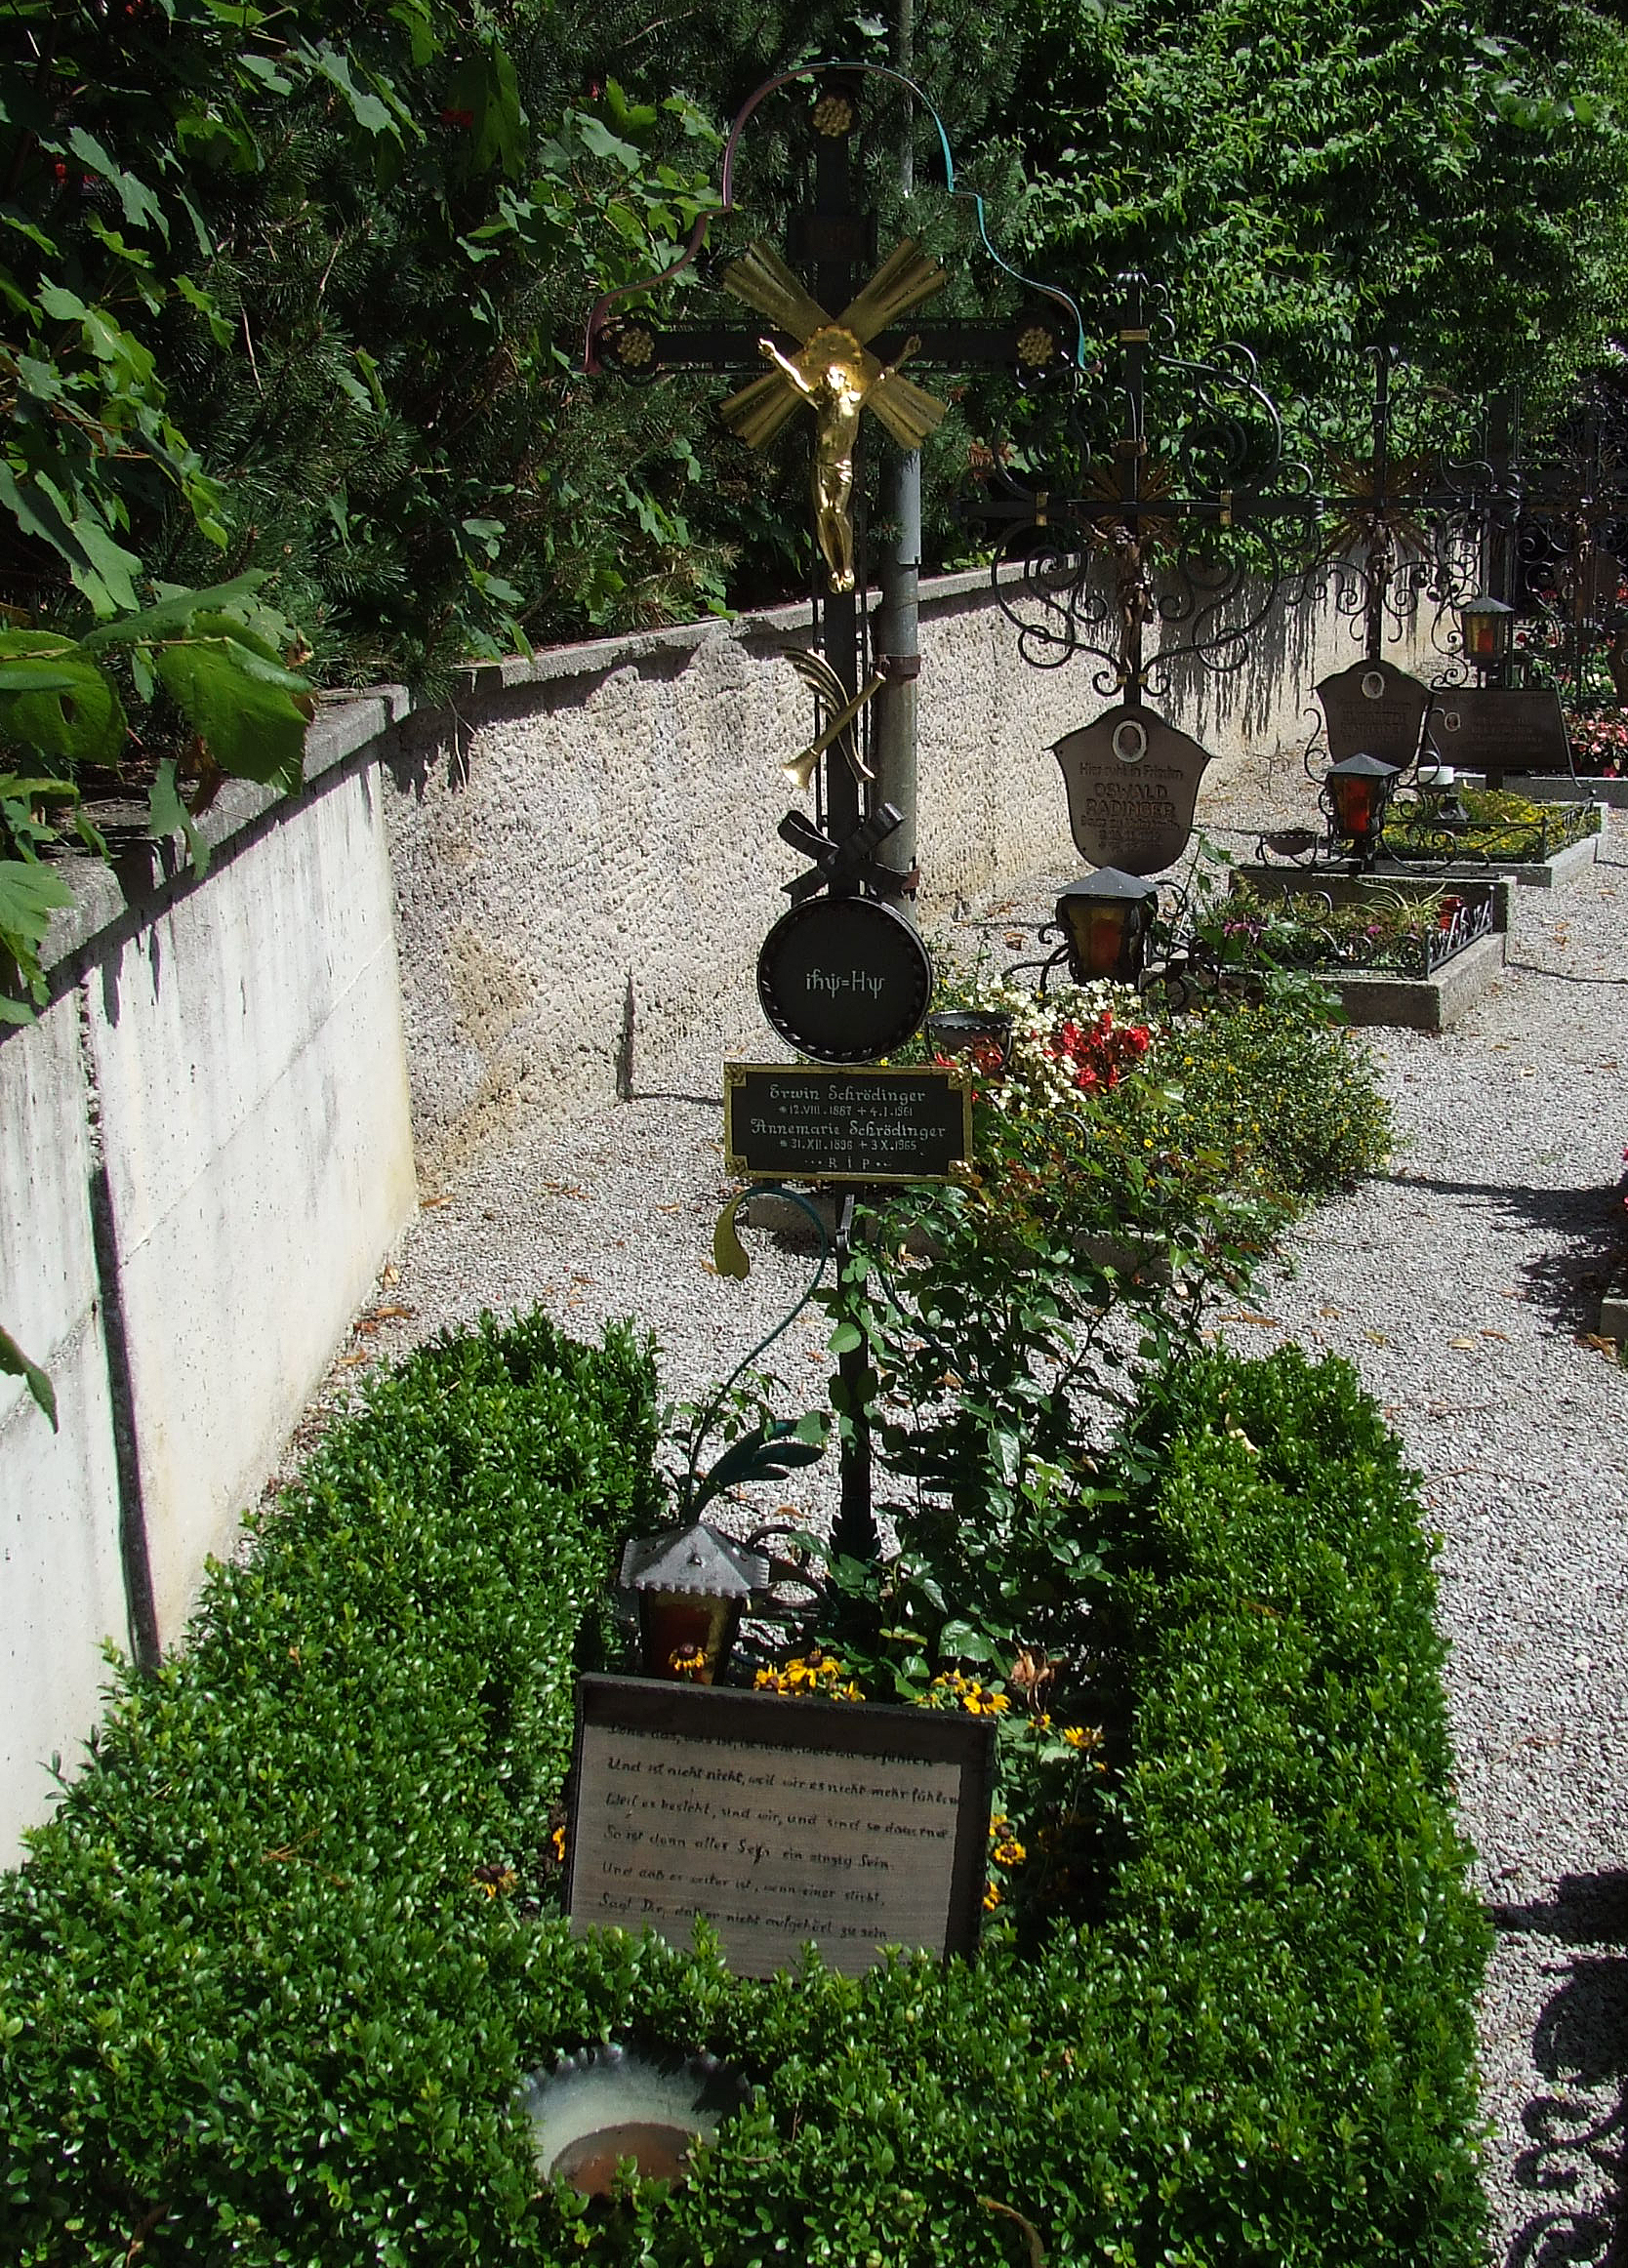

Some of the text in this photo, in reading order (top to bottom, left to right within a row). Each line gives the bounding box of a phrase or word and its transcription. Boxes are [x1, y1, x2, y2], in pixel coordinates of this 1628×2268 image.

[770, 1084, 925, 1106] Erwin Schrödinger
[750, 1118, 946, 1141] Annemarie Schrödinger
[607, 1757, 640, 1772] Und
[648, 1763, 664, 1775] ist
[668, 1766, 702, 1779] nicht
[749, 1774, 775, 1786] weil
[783, 1776, 804, 1788] wir
[809, 1782, 824, 1791] es
[828, 1784, 865, 1795] nicht
[603, 1823, 621, 1839] So
